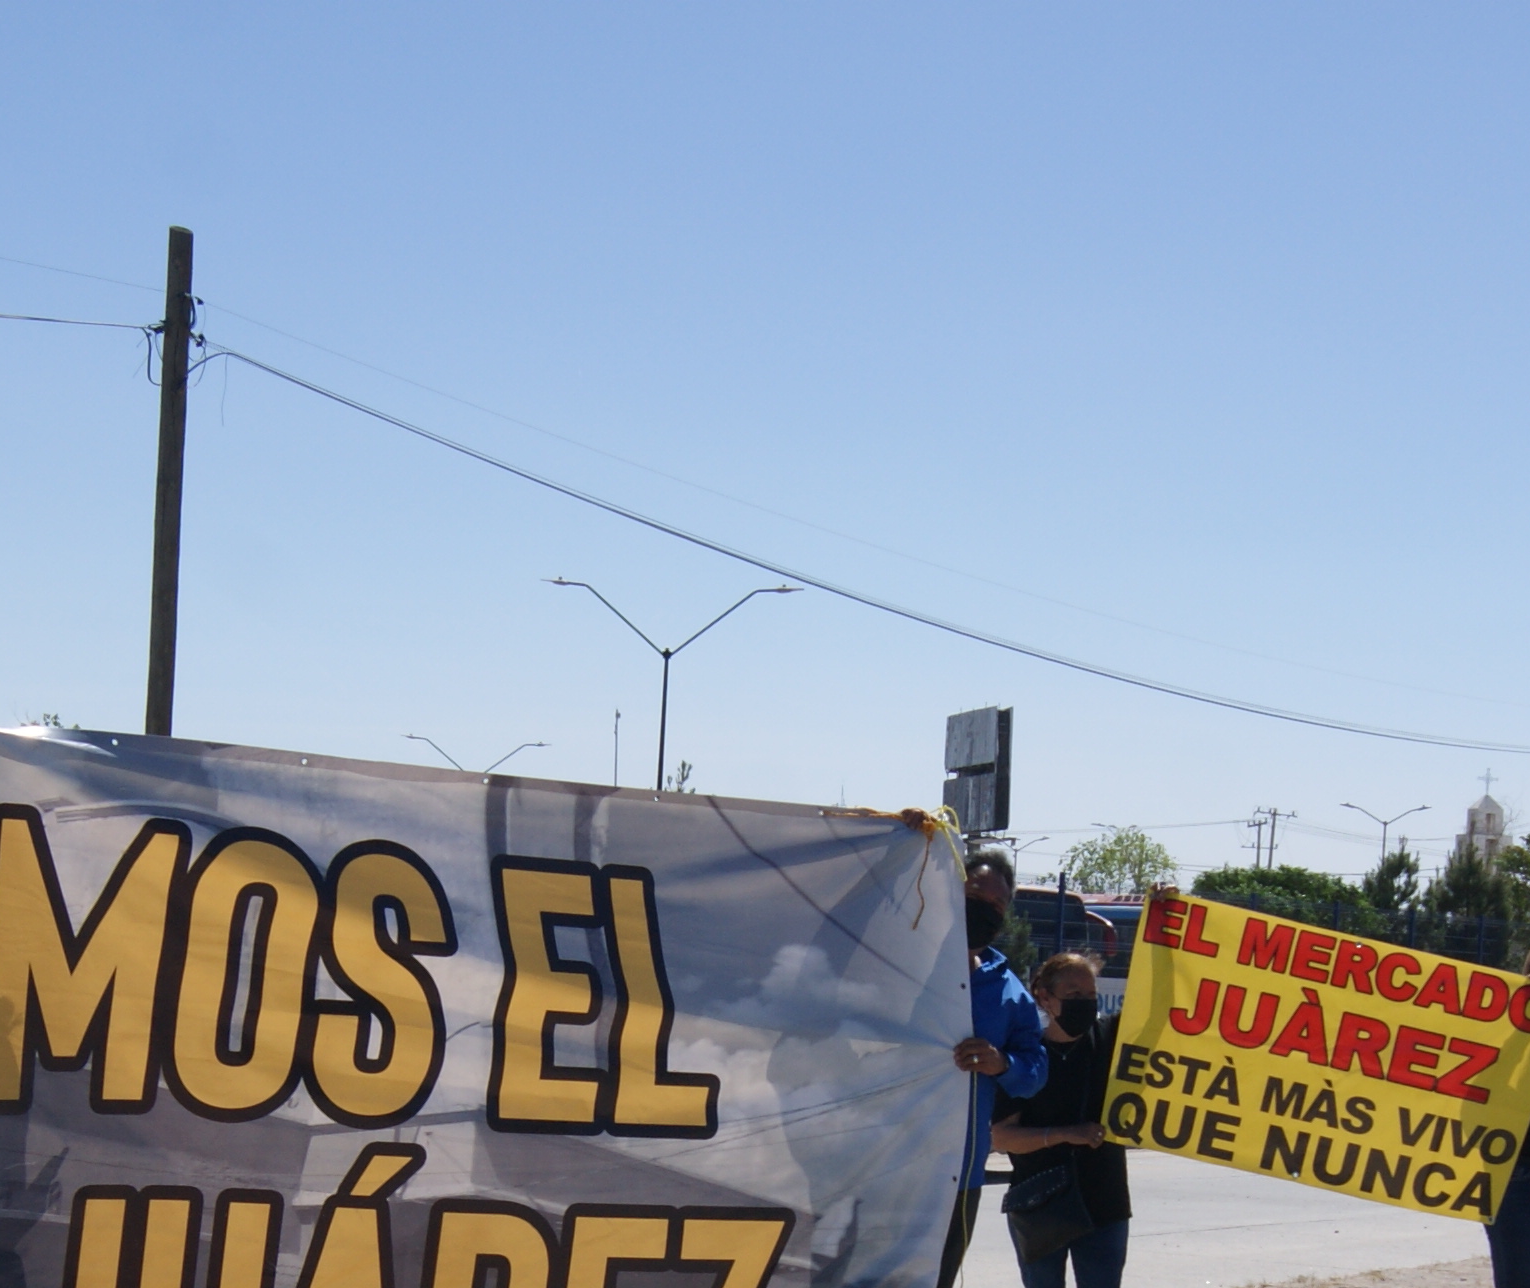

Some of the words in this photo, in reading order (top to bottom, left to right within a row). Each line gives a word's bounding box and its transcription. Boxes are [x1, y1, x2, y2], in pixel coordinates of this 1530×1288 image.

[1143, 898, 1219, 958] EL
[487, 854, 720, 1139] EL
[1107, 1092, 1242, 1161] QUE
[1260, 1126, 1496, 1217] NUNCA
[1399, 1106, 1517, 1165] VIVO
